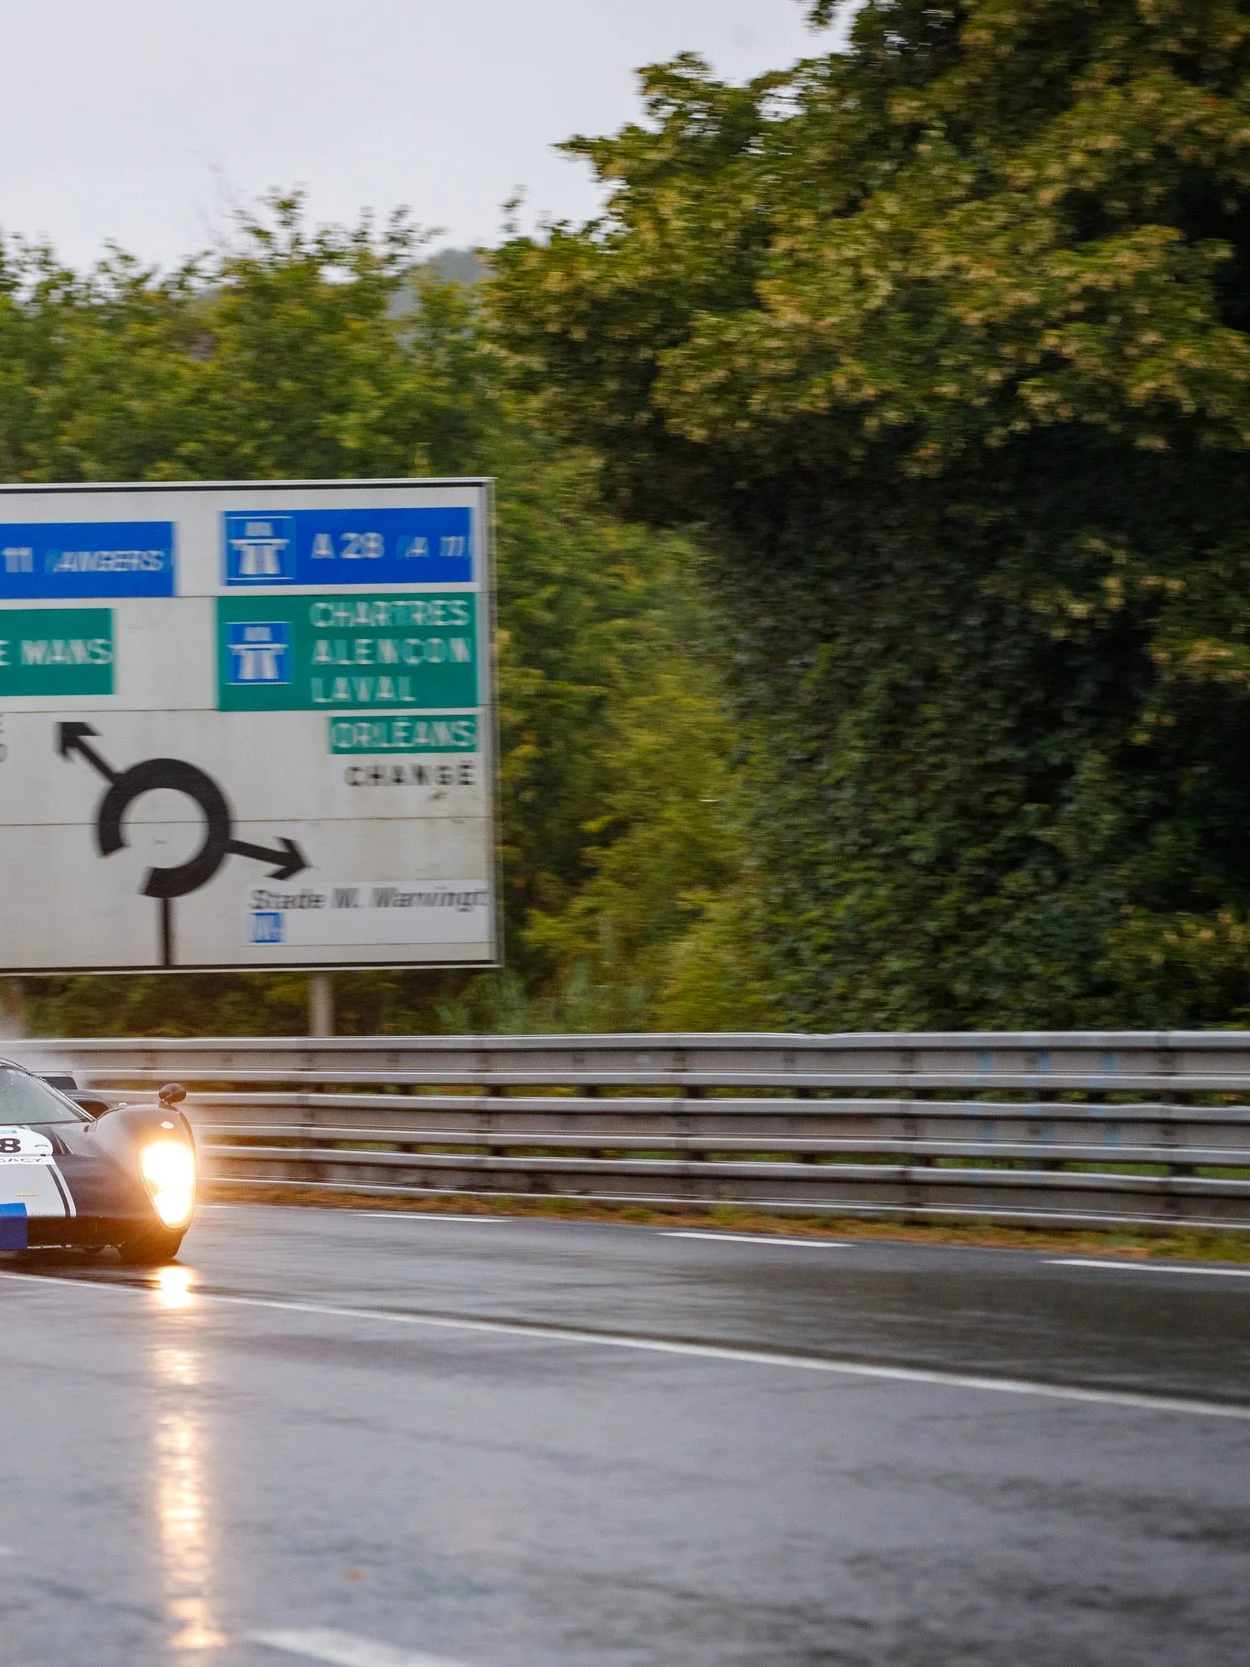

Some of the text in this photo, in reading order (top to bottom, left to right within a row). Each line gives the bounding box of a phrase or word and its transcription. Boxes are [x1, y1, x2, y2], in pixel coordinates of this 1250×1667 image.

[310, 533, 335, 559] A
[340, 532, 384, 559] 28
[1, 547, 33, 573] 11
[310, 600, 470, 627] CHARTRES
[20, 638, 112, 665] MANS
[310, 676, 417, 703] LAVAL
